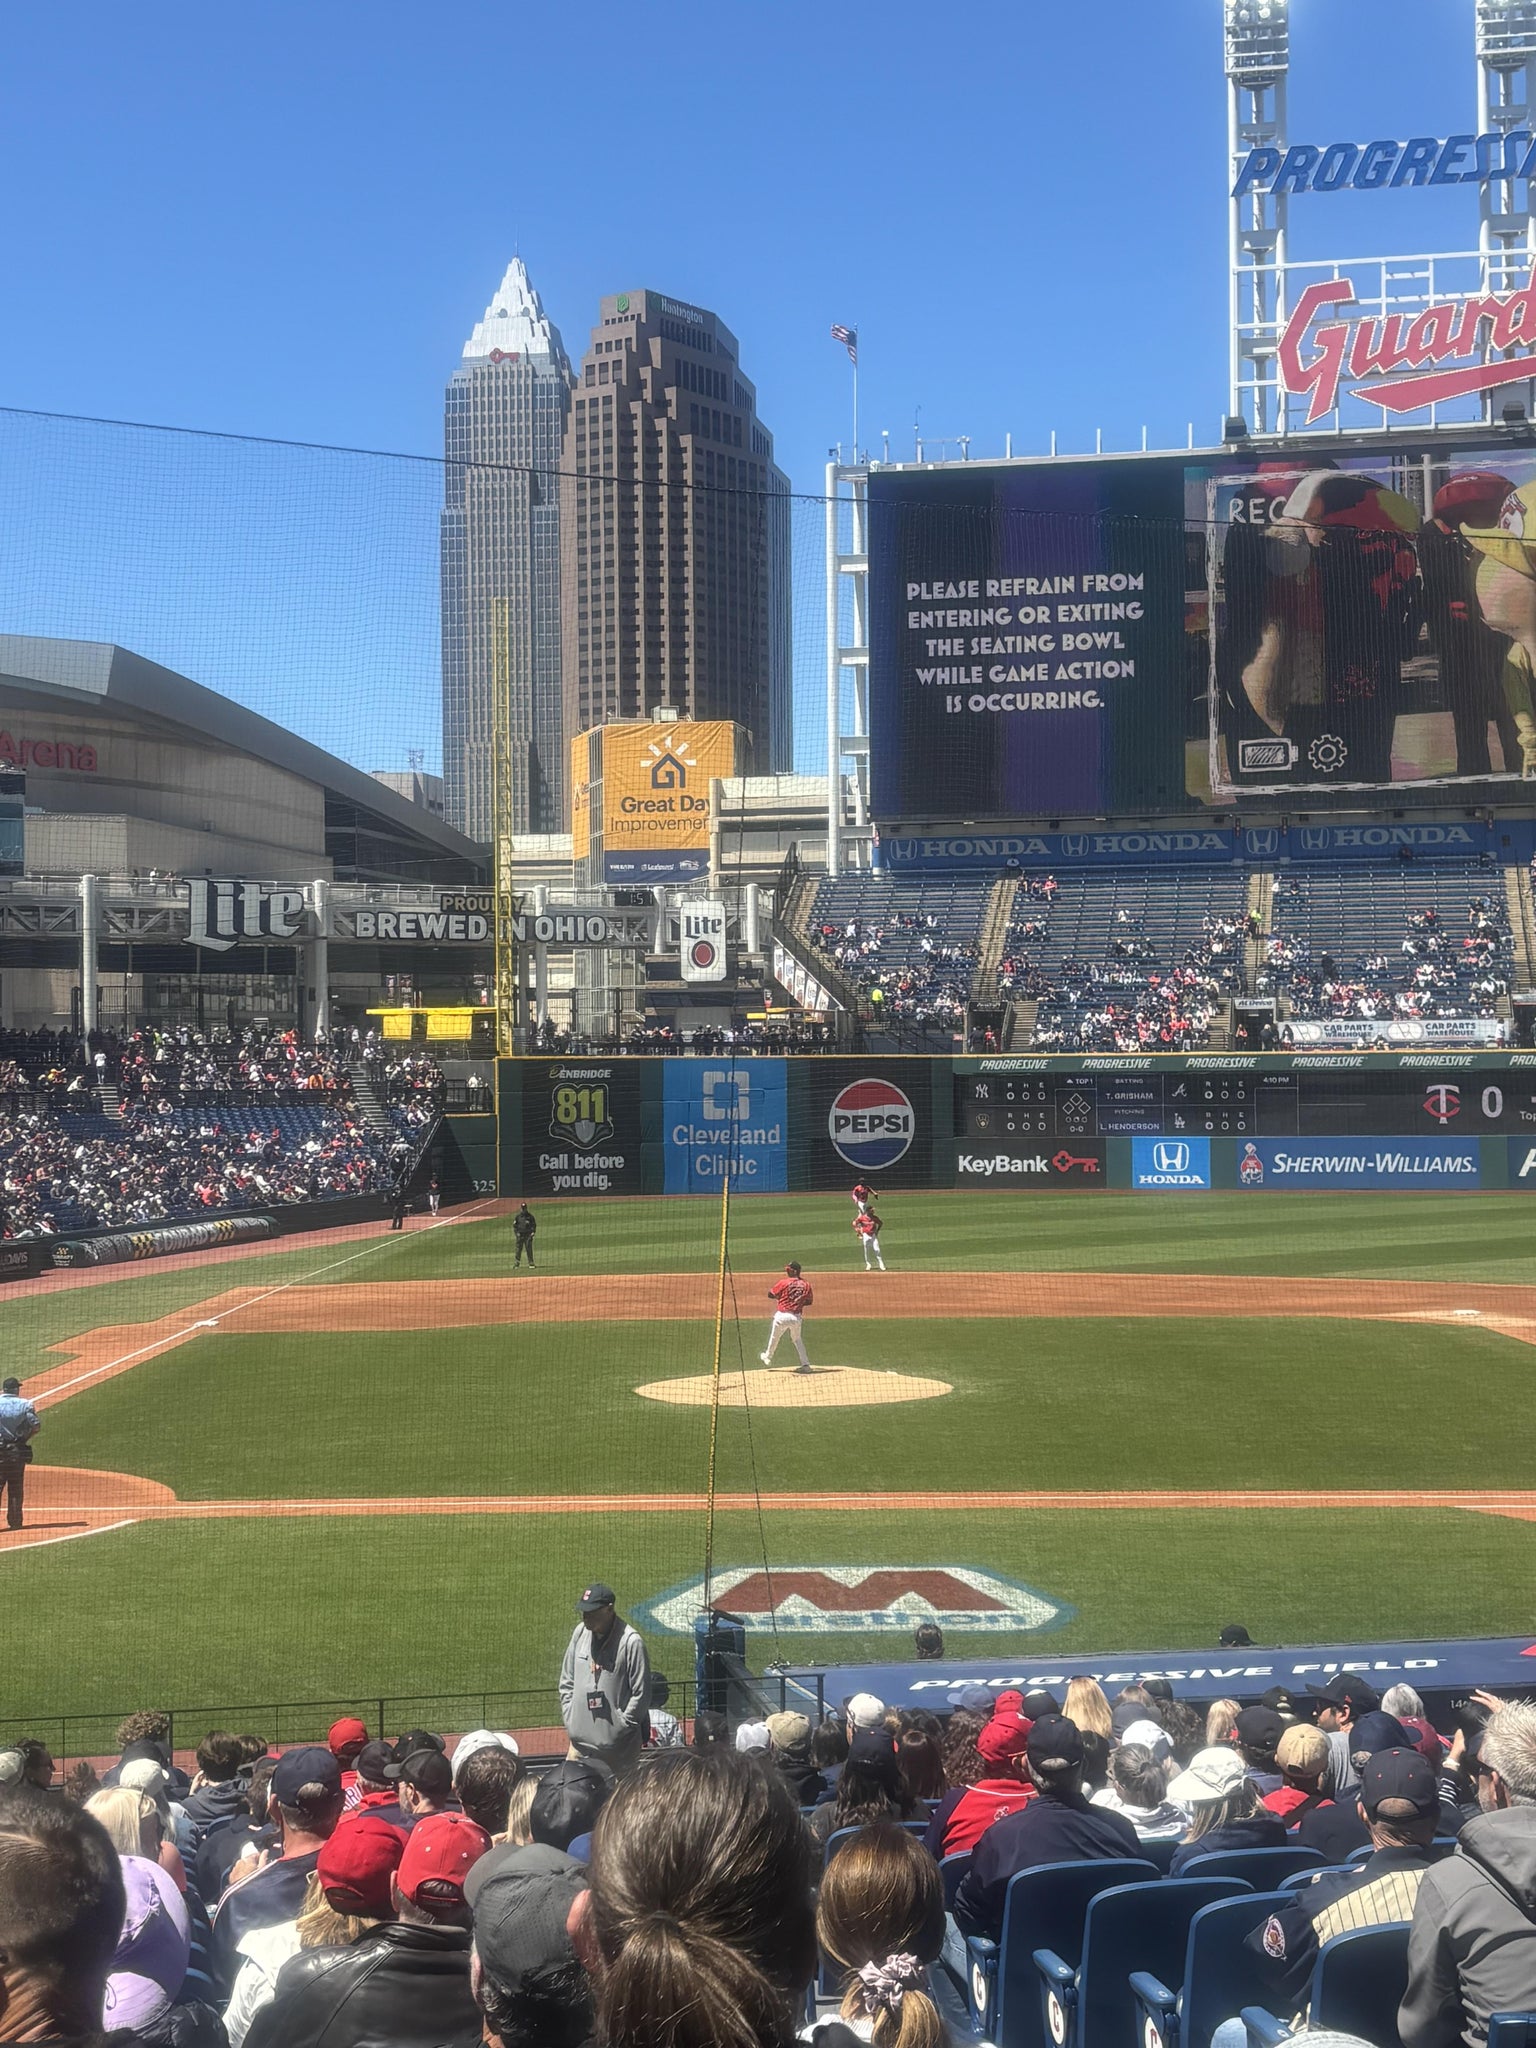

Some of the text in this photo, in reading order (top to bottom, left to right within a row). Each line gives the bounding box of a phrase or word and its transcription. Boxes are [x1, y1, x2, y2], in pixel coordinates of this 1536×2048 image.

[661, 297, 704, 324] Huntington
[1228, 495, 1289, 524] REC
[906, 572, 1145, 600] PLEASE REFRAIN FROM
[907, 601, 1145, 629] ENTERING OR EXITING
[926, 631, 1126, 657] THE SEATING BOWL
[916, 660, 1136, 686] WHILE GAME ACTION
[946, 690, 1105, 713] IS OCCURRING.
[0, 730, 98, 772] Arena
[620, 796, 676, 814] Great
[1094, 832, 1229, 853] HONDA
[1334, 826, 1474, 847] HONDA
[922, 838, 1052, 857] HONDA
[182, 878, 304, 952] Lite
[356, 912, 489, 941] BREWED
[533, 914, 608, 943] OHIO
[685, 915, 723, 940] Lite
[1323, 1023, 1374, 1033] CAR PARTS
[1425, 1022, 1476, 1031] CAR PARTS
[1425, 1029, 1476, 1038] WAREHOUSE
[979, 1058, 1048, 1071] PROGRESSIVE
[1082, 1058, 1153, 1070] PROGRESSIVE
[1186, 1057, 1256, 1069] PROGRESSIVE
[1292, 1056, 1363, 1068] PROGRESSIVE
[1400, 1055, 1473, 1067] PROGRESSIVE
[558, 1069, 611, 1079] ENBRIDGE
[557, 1088, 605, 1124] 811
[1481, 1086, 1503, 1118] 0
[672, 1124, 781, 1146] Cleveland
[835, 1115, 910, 1134] PEPSI
[539, 1153, 625, 1170] Call before
[695, 1155, 758, 1176] Clinic
[958, 1155, 1050, 1177] KeyBank
[472, 1180, 496, 1193] 325
[552, 1171, 612, 1192] you dig.
[1139, 1174, 1205, 1185] HONDA
[742, 1612, 1029, 1627] arathon
[1292, 1658, 1438, 1676] FIELD
